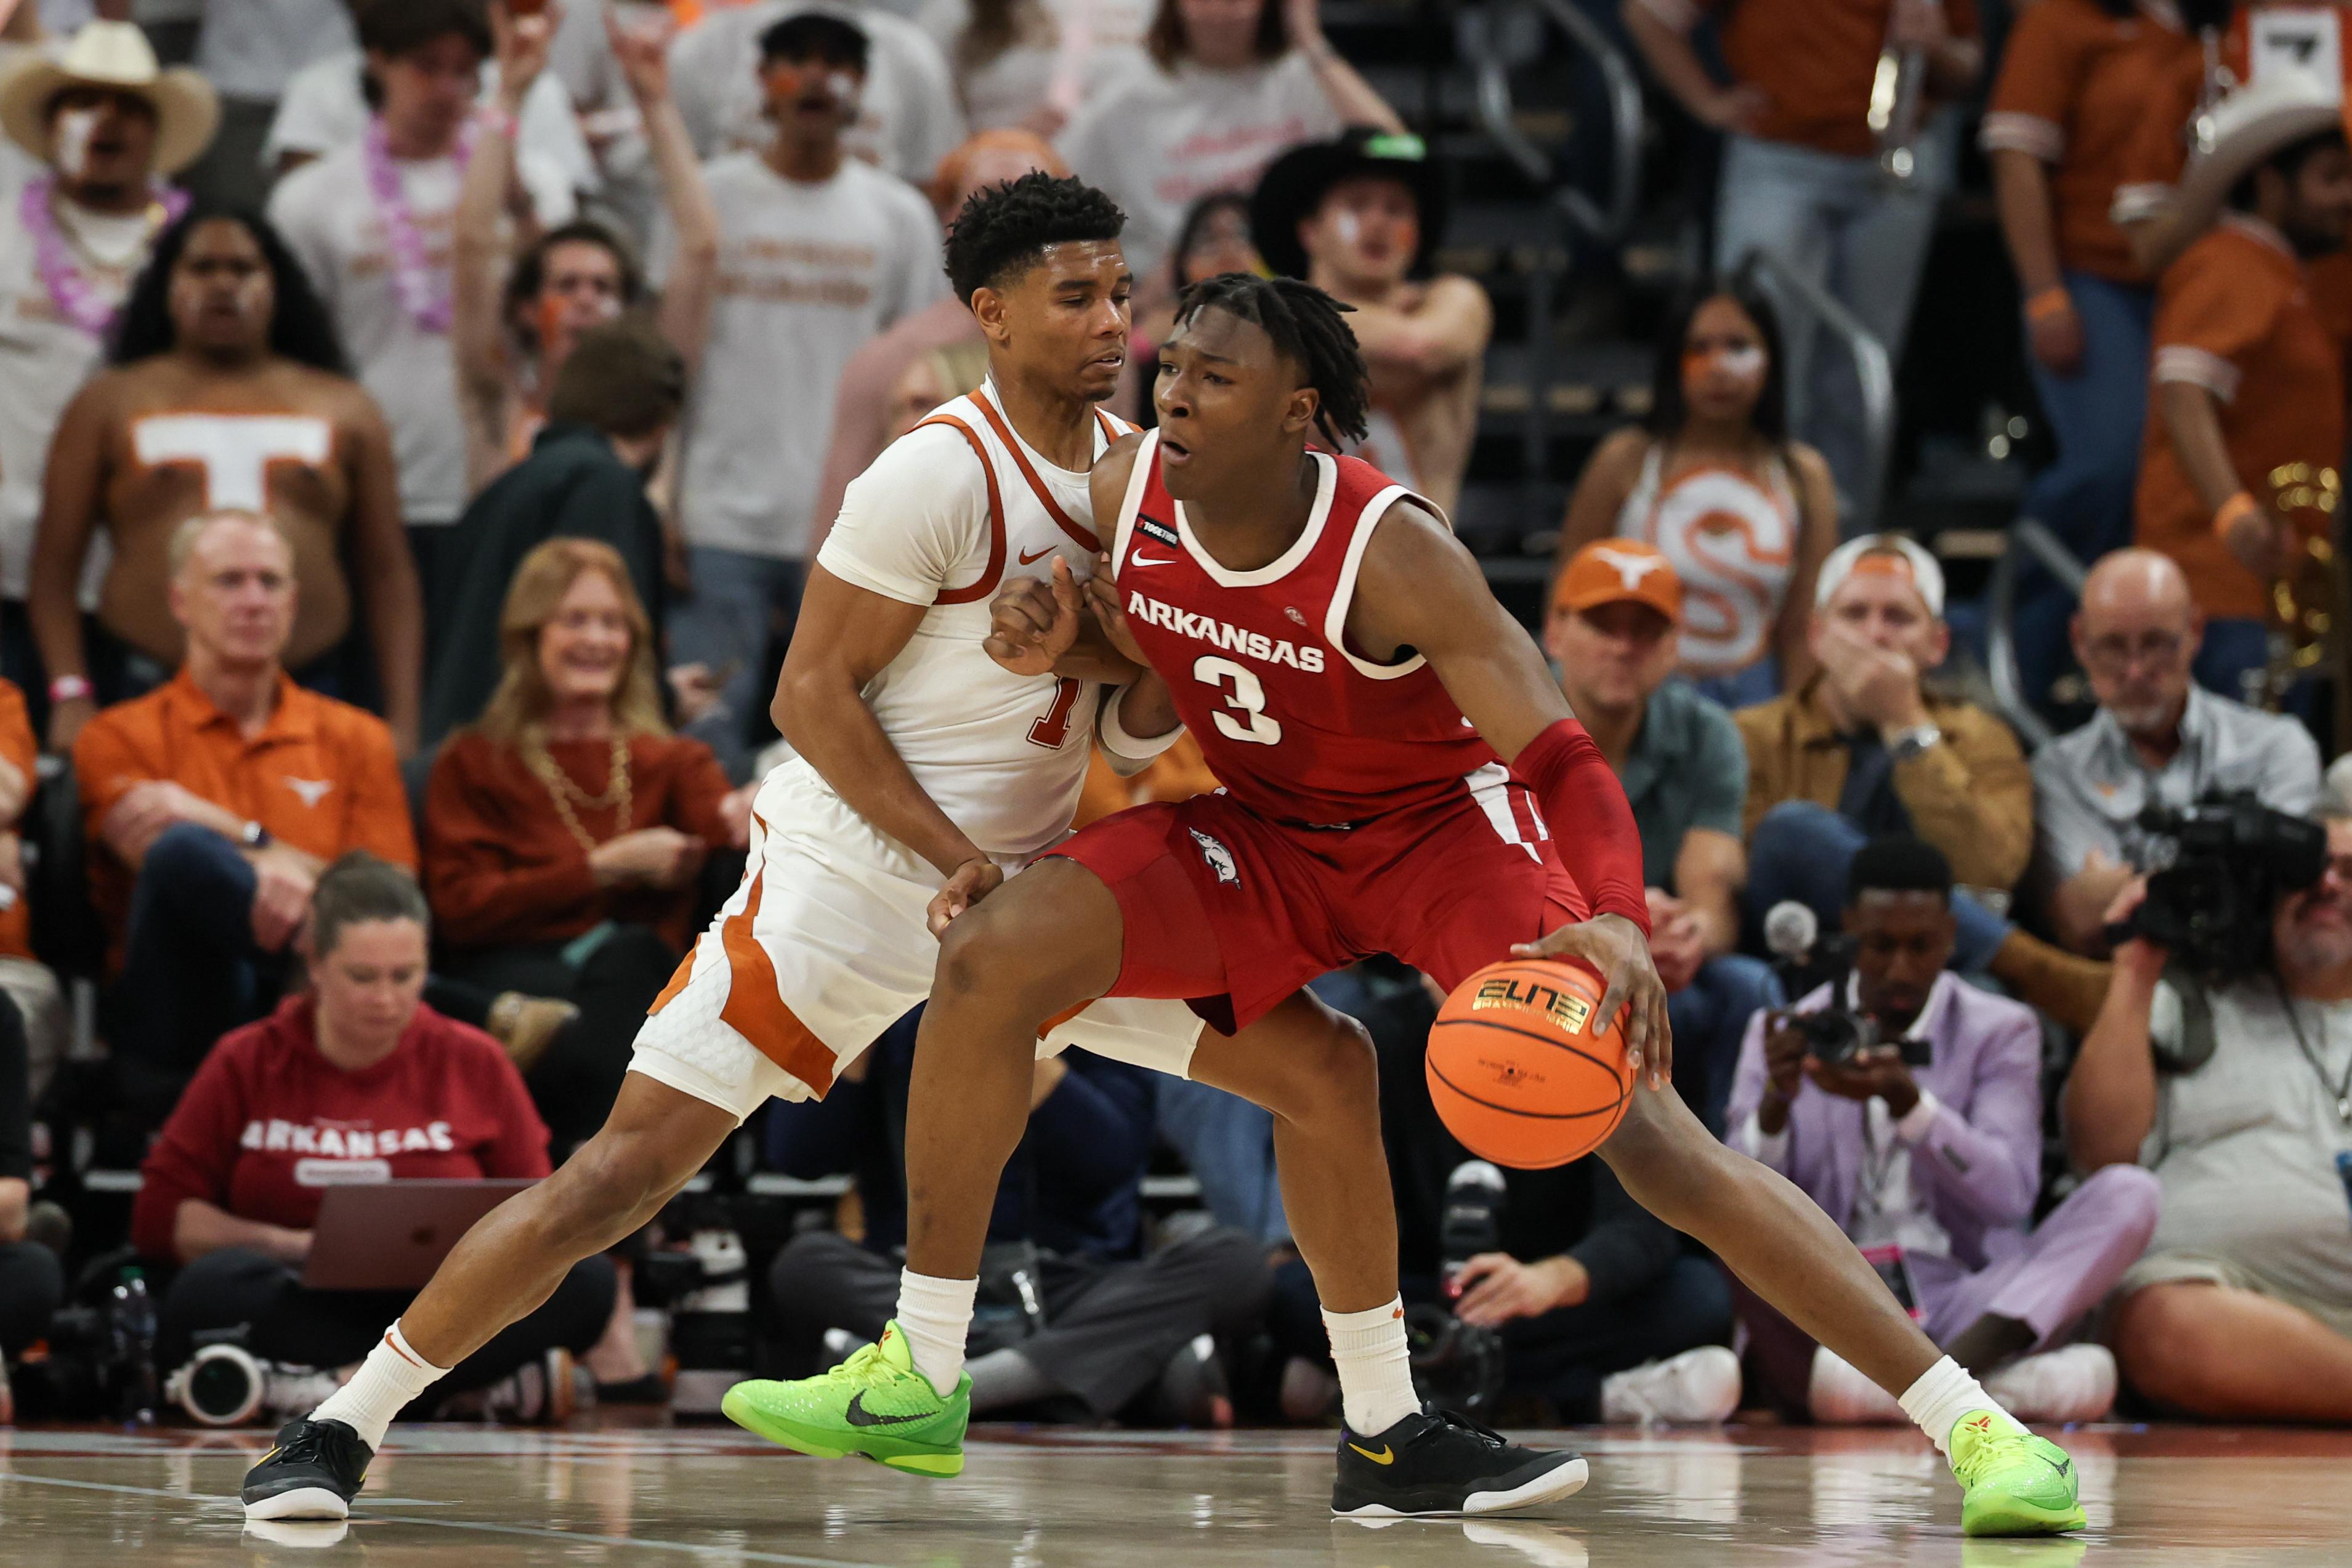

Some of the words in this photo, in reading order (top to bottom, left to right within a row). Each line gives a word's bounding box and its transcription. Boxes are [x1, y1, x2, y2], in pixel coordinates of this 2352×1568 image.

[131, 410, 331, 515] T
[1655, 463, 1790, 673] S
[1128, 589, 1325, 674] ARKANSAS
[1025, 676, 1083, 750] 1
[1192, 655, 1282, 746] 3
[241, 1118, 454, 1157] ARKANSAS
